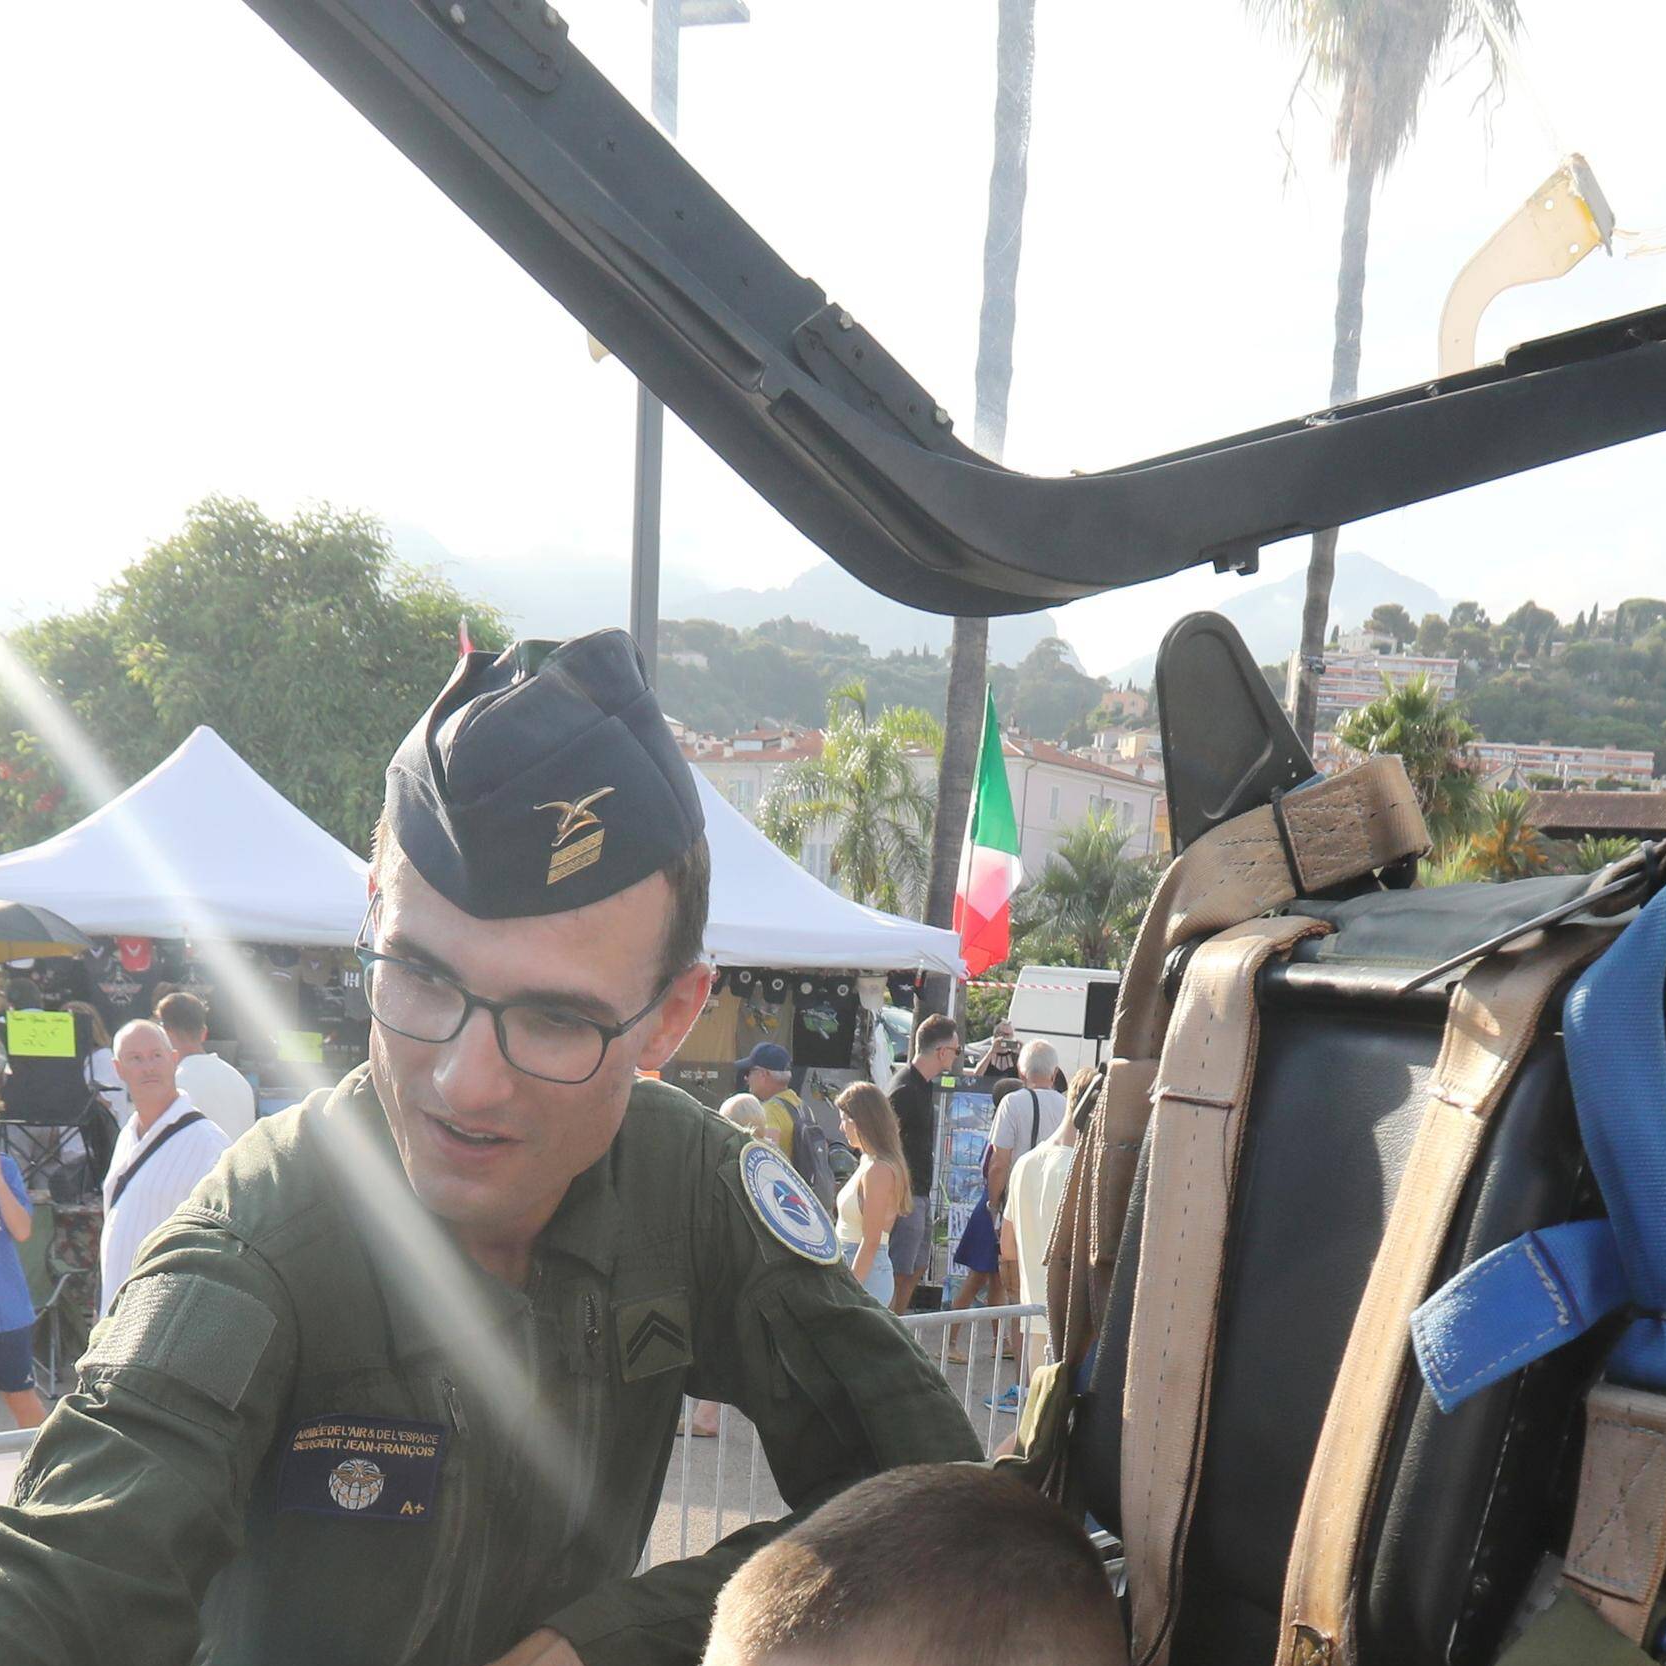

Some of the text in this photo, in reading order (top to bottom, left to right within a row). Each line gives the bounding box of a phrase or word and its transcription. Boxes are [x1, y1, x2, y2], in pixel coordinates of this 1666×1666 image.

[292, 1438, 436, 1458] SERGENT JEAN-FRANÇOIS
[400, 1500, 426, 1515] A+
